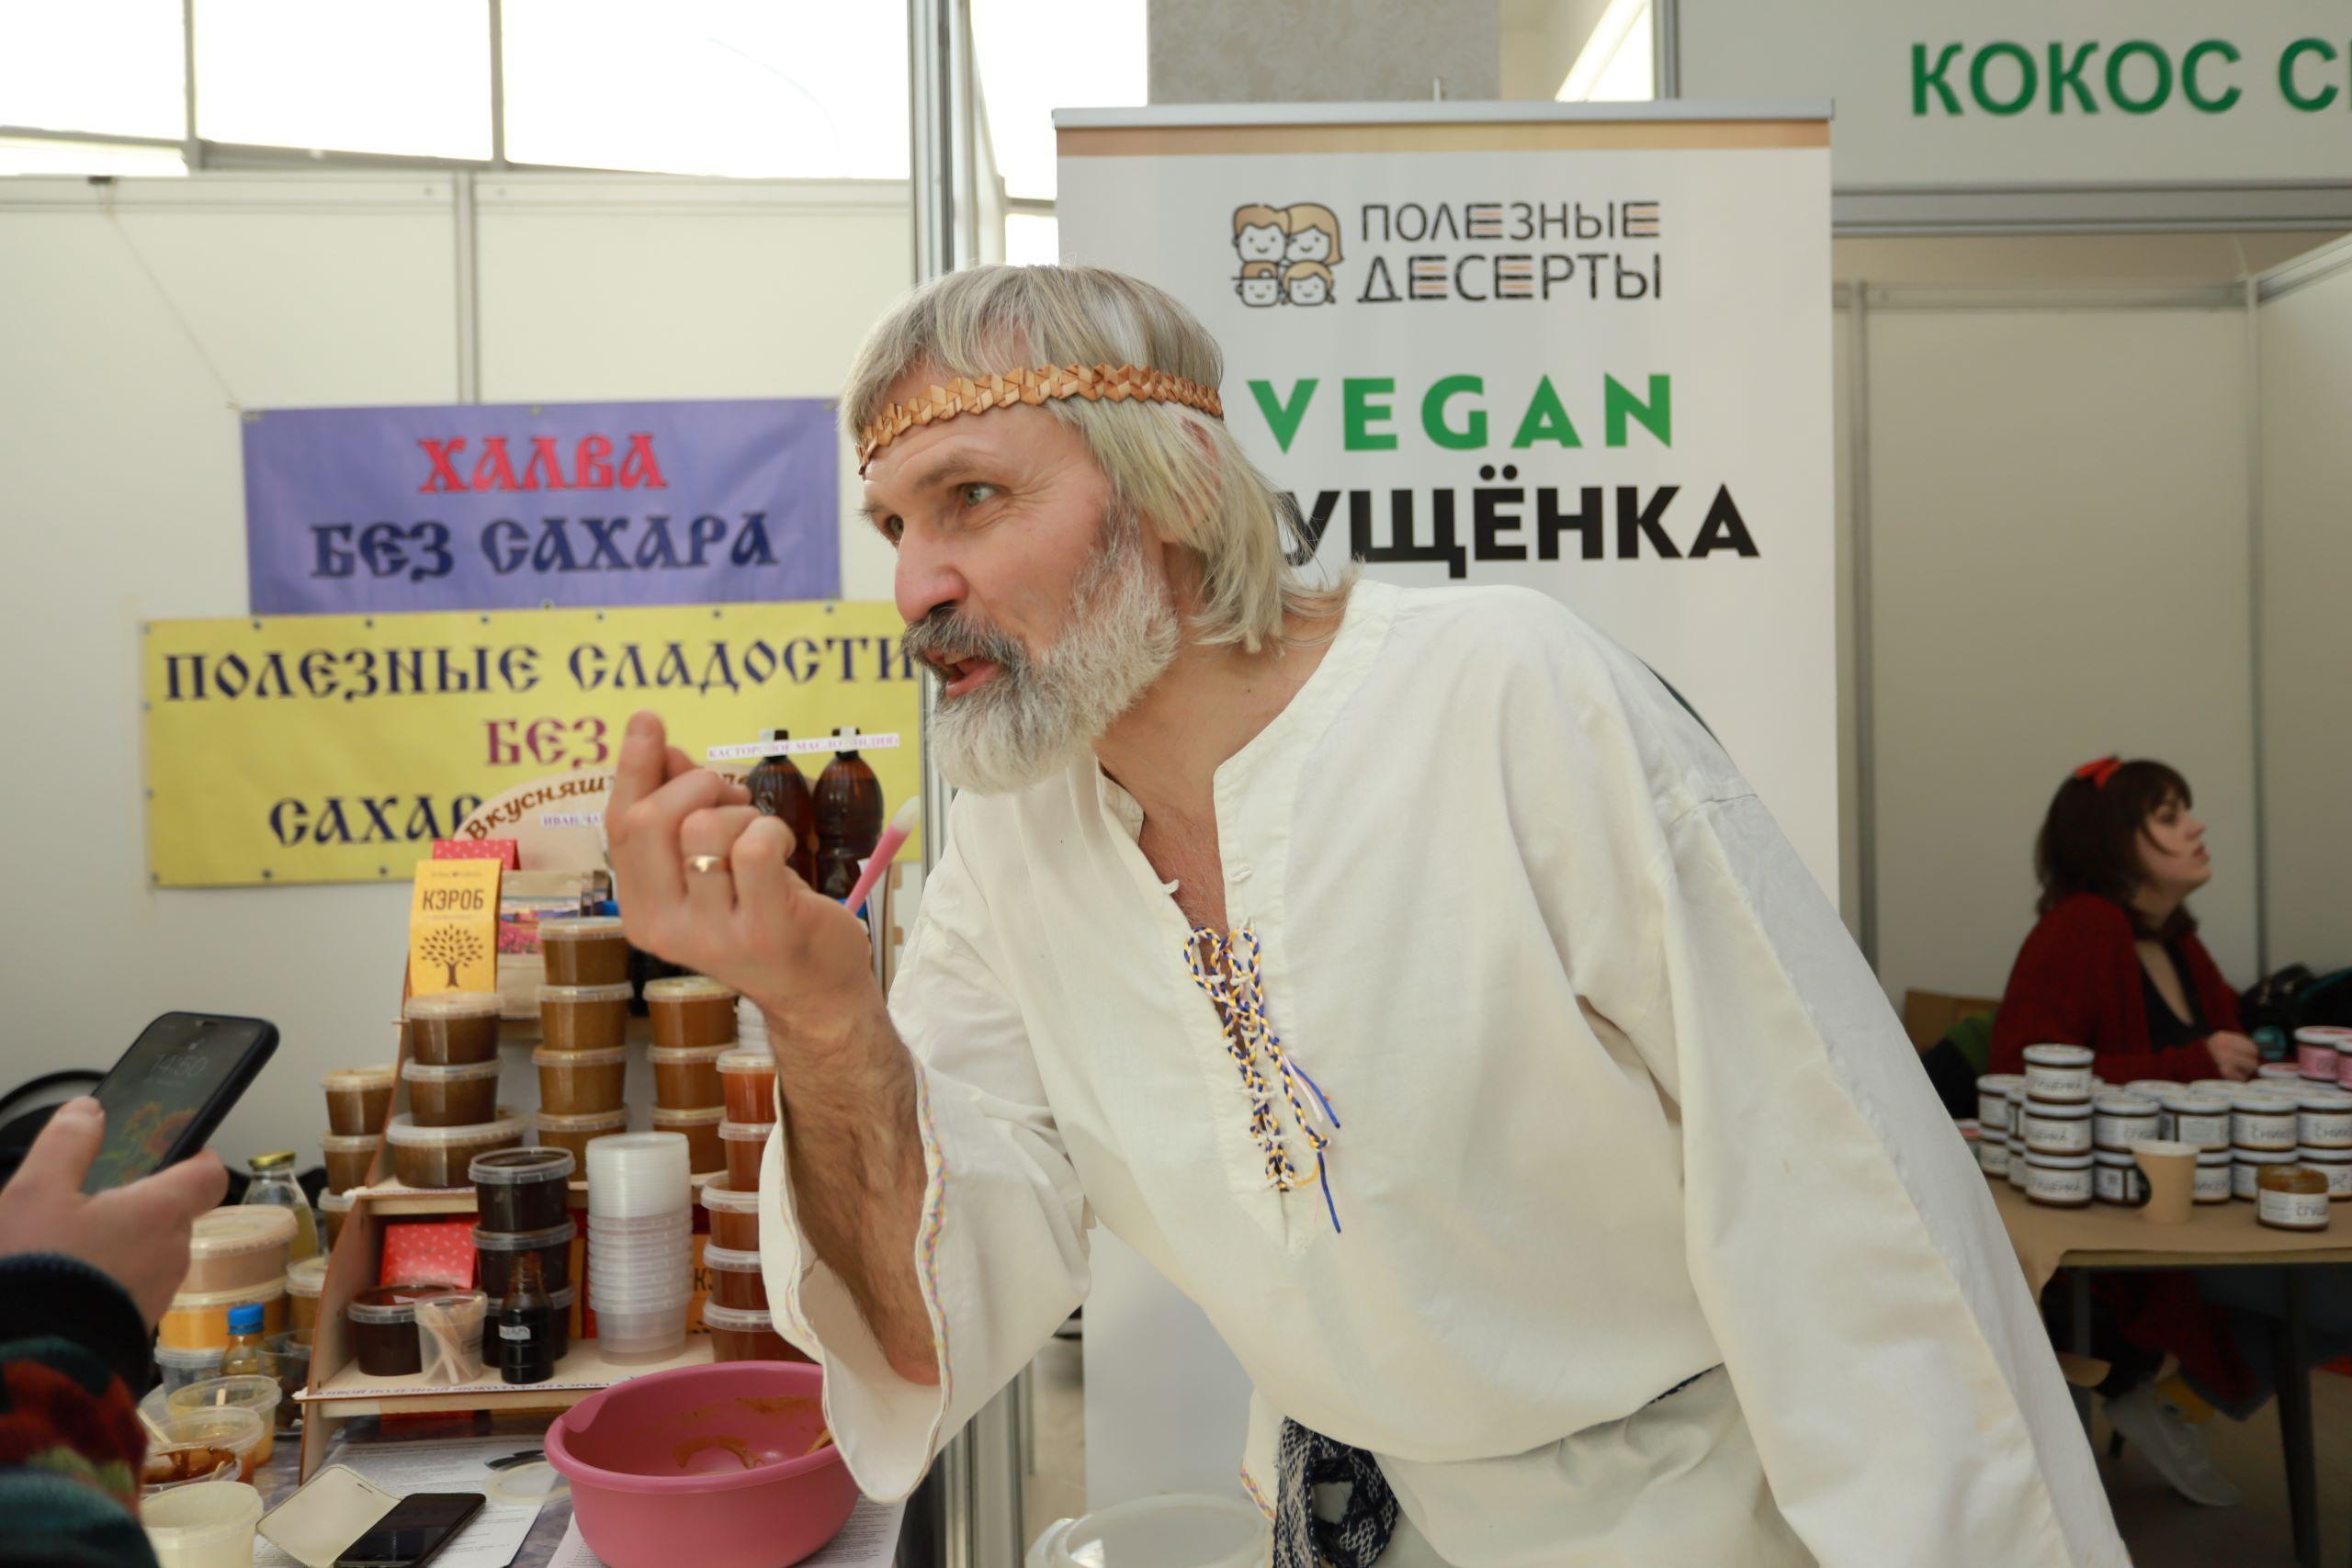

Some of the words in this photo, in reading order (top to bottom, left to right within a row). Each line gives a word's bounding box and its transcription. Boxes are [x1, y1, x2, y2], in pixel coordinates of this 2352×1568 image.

[1910, 39, 2243, 117] КОКОС
[2277, 38, 2352, 113] С
[1361, 200, 1661, 243] ПОЛЕЗНЫЕ
[1356, 253, 1662, 305] ДЕСЕРТЫ
[1247, 373, 1672, 455] VEGAN
[417, 433, 668, 494] ХАЛВА
[311, 520, 455, 582] БЕЗ
[480, 511, 779, 575] САХАРА
[1273, 463, 1760, 580] УЩЁНКА
[164, 645, 541, 703] ПОЛЕЗНЫЕ
[568, 636, 914, 696] СЛАДОСТИ
[485, 716, 608, 769] БЕЗ
[268, 793, 481, 848] САХАР
[422, 887, 485, 912] КЭРОБ
